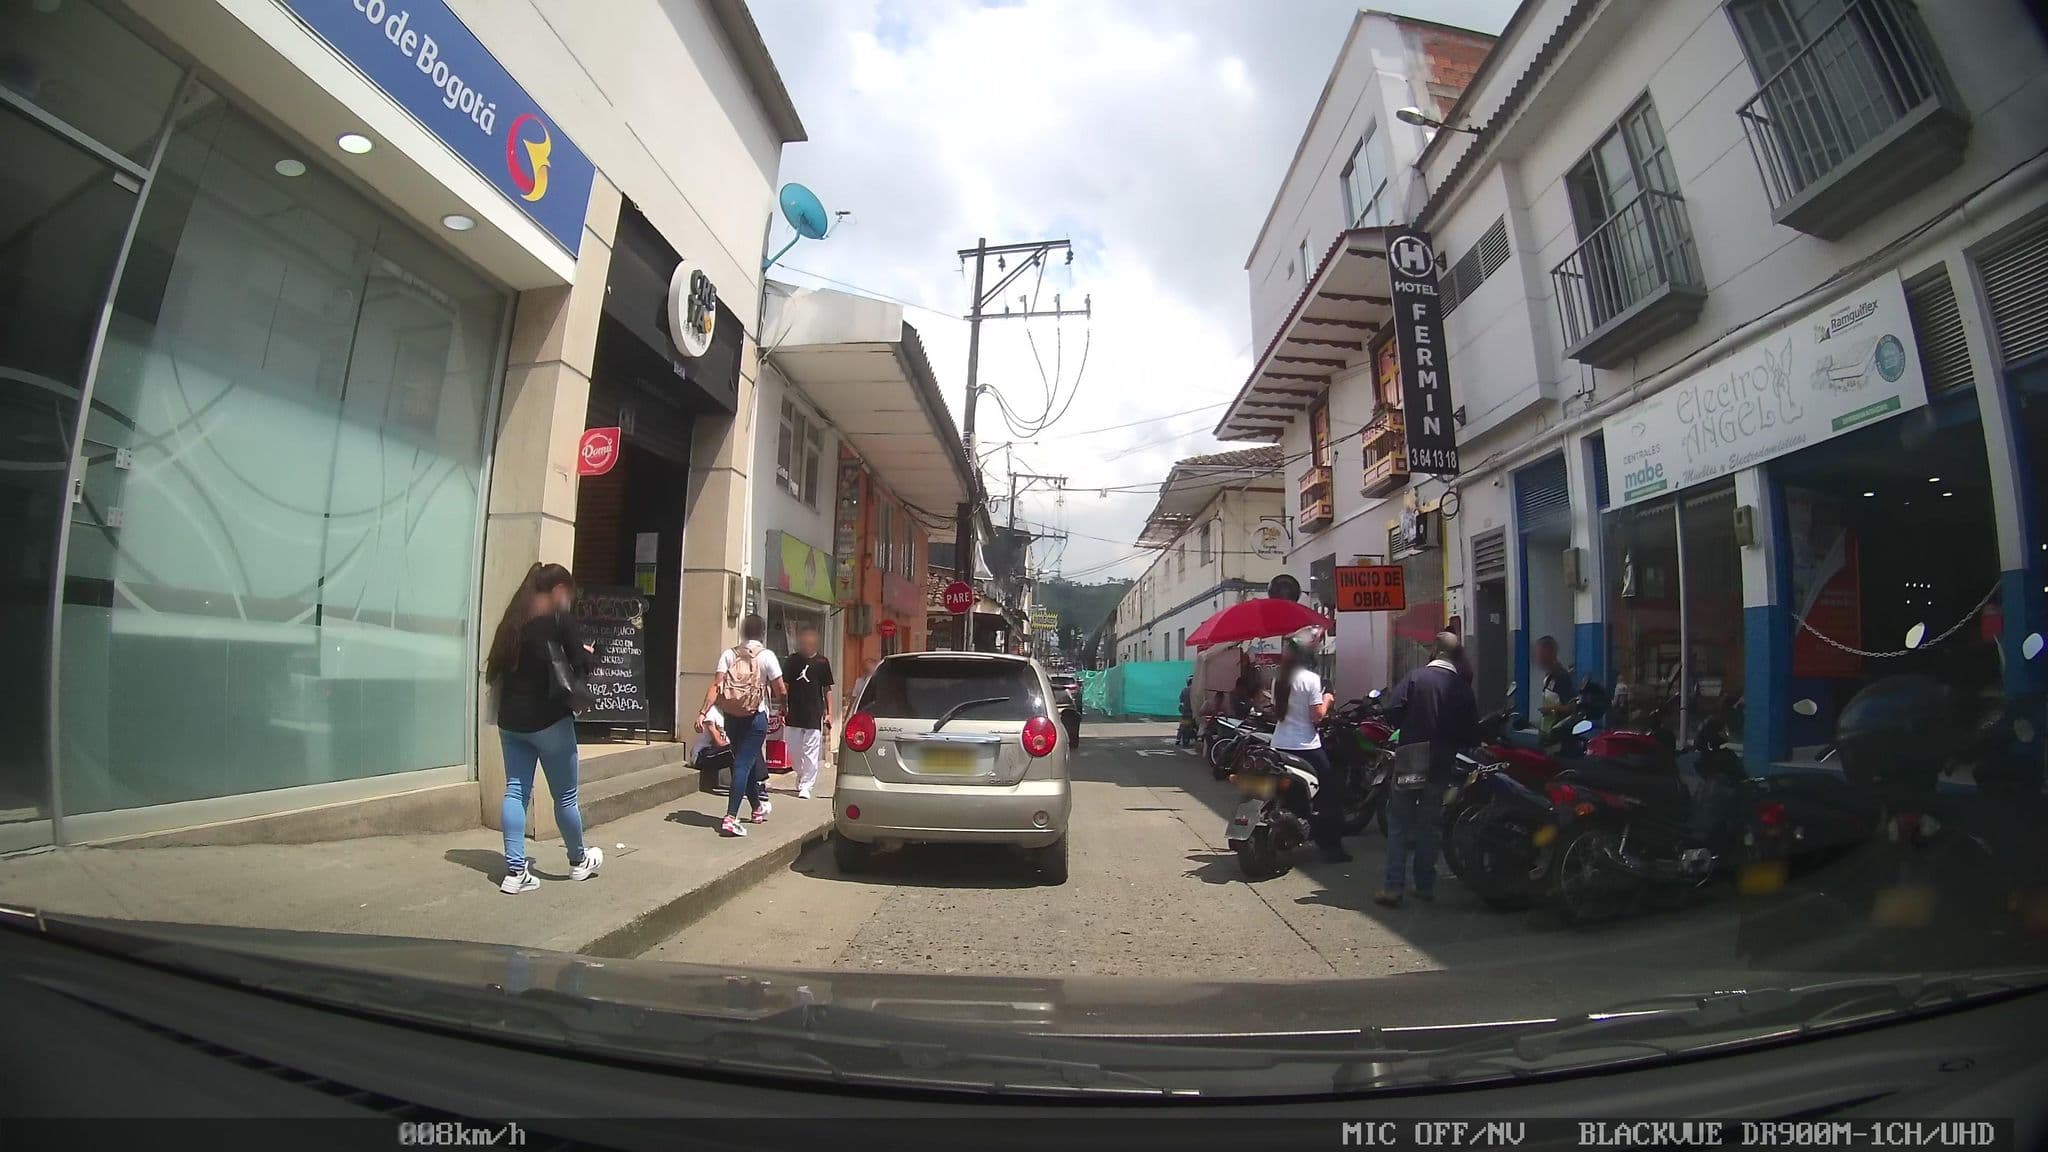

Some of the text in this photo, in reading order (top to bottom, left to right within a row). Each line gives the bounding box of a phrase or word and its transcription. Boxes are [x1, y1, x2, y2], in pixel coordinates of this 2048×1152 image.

[384, 10, 418, 57] de
[416, 34, 496, 135] Bogotá
[1400, 242, 1426, 270] H
[1395, 281, 1438, 296] HOTEL
[1412, 303, 1440, 436] FERMIN
[1623, 443, 1661, 465] CENTRALES
[1624, 459, 1664, 489] mabe
[1340, 570, 1401, 587] INICIO DE
[946, 592, 970, 604] PARE
[1353, 591, 1391, 607] OBRA
